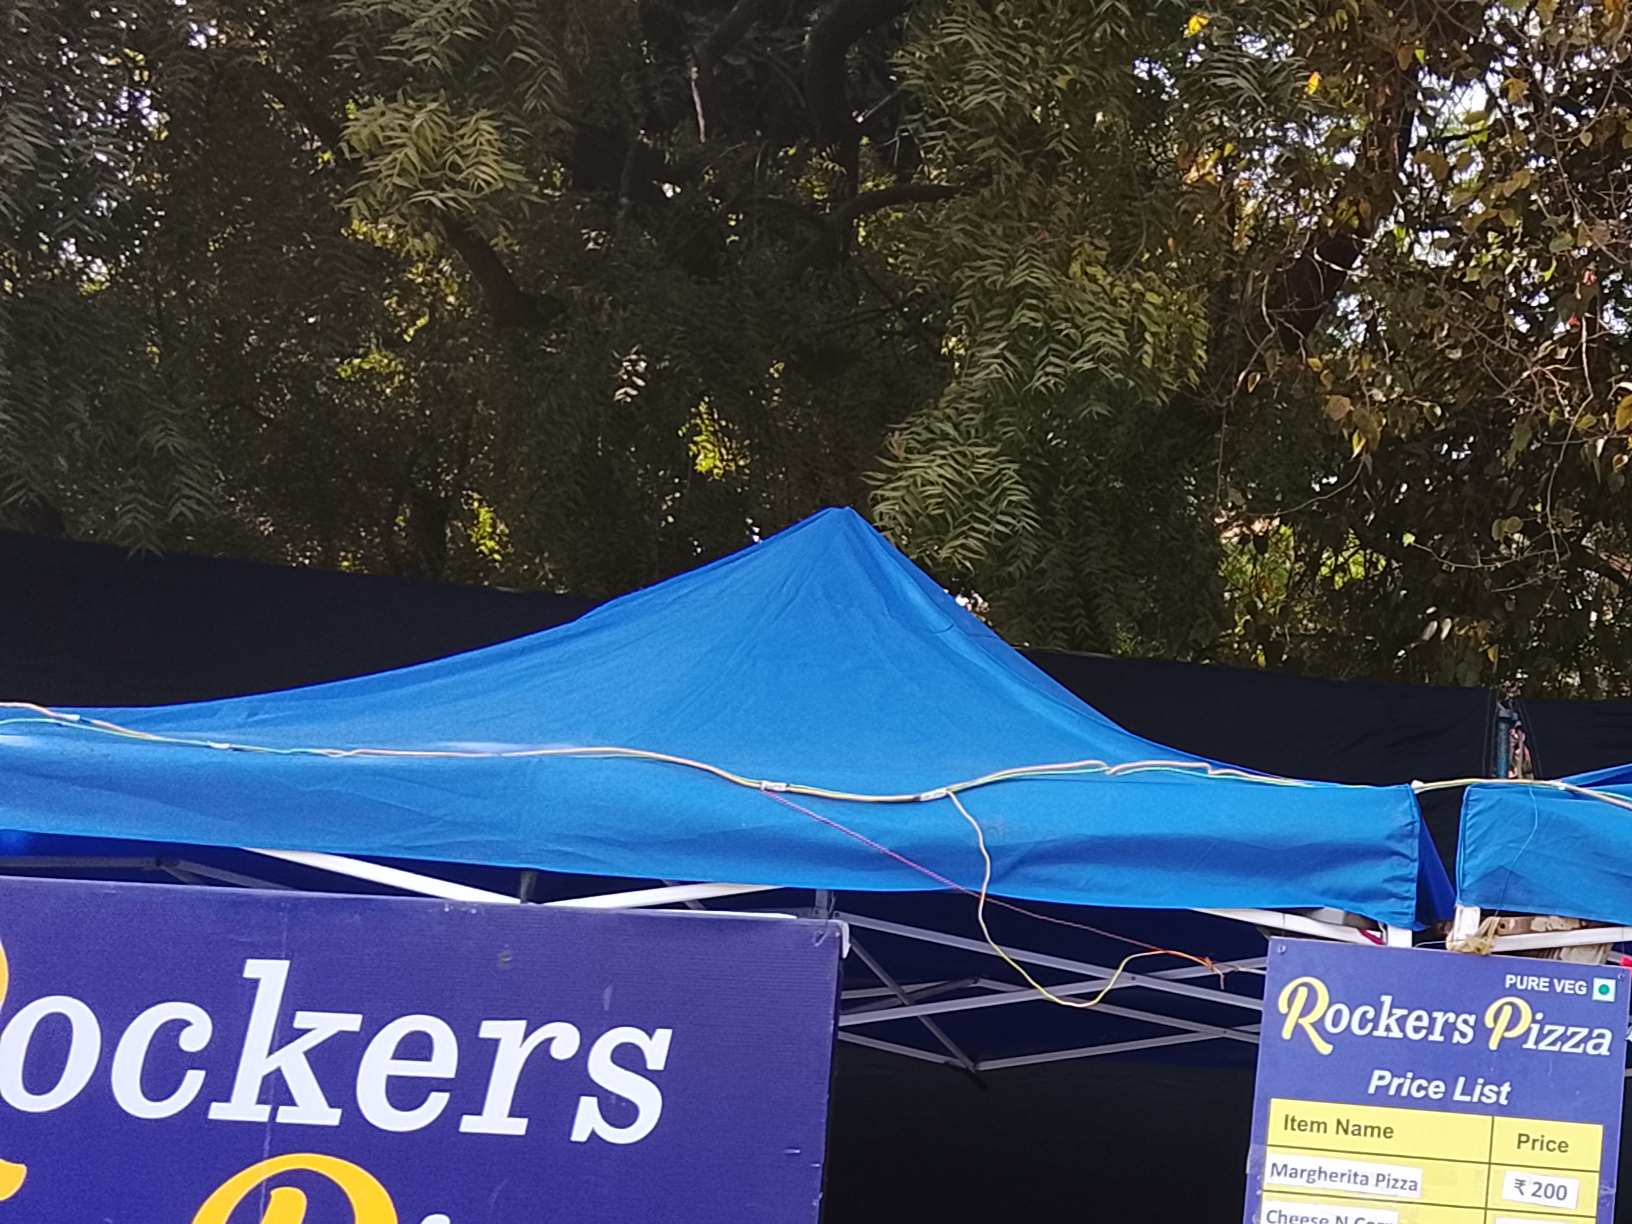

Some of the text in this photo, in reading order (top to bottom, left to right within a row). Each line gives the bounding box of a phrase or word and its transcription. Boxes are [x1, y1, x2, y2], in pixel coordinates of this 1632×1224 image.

[1504, 974, 1588, 996] PURE VEG
[1277, 976, 1613, 1057] Rockers Pizza
[0, 940, 673, 1199] ockers
[1368, 1069, 1512, 1106] Price List
[1283, 1112, 1395, 1140] Item Name
[1516, 1132, 1570, 1154] Price
[1269, 1161, 1419, 1193] Margherita Pizza
[1530, 1181, 1569, 1202] 200
